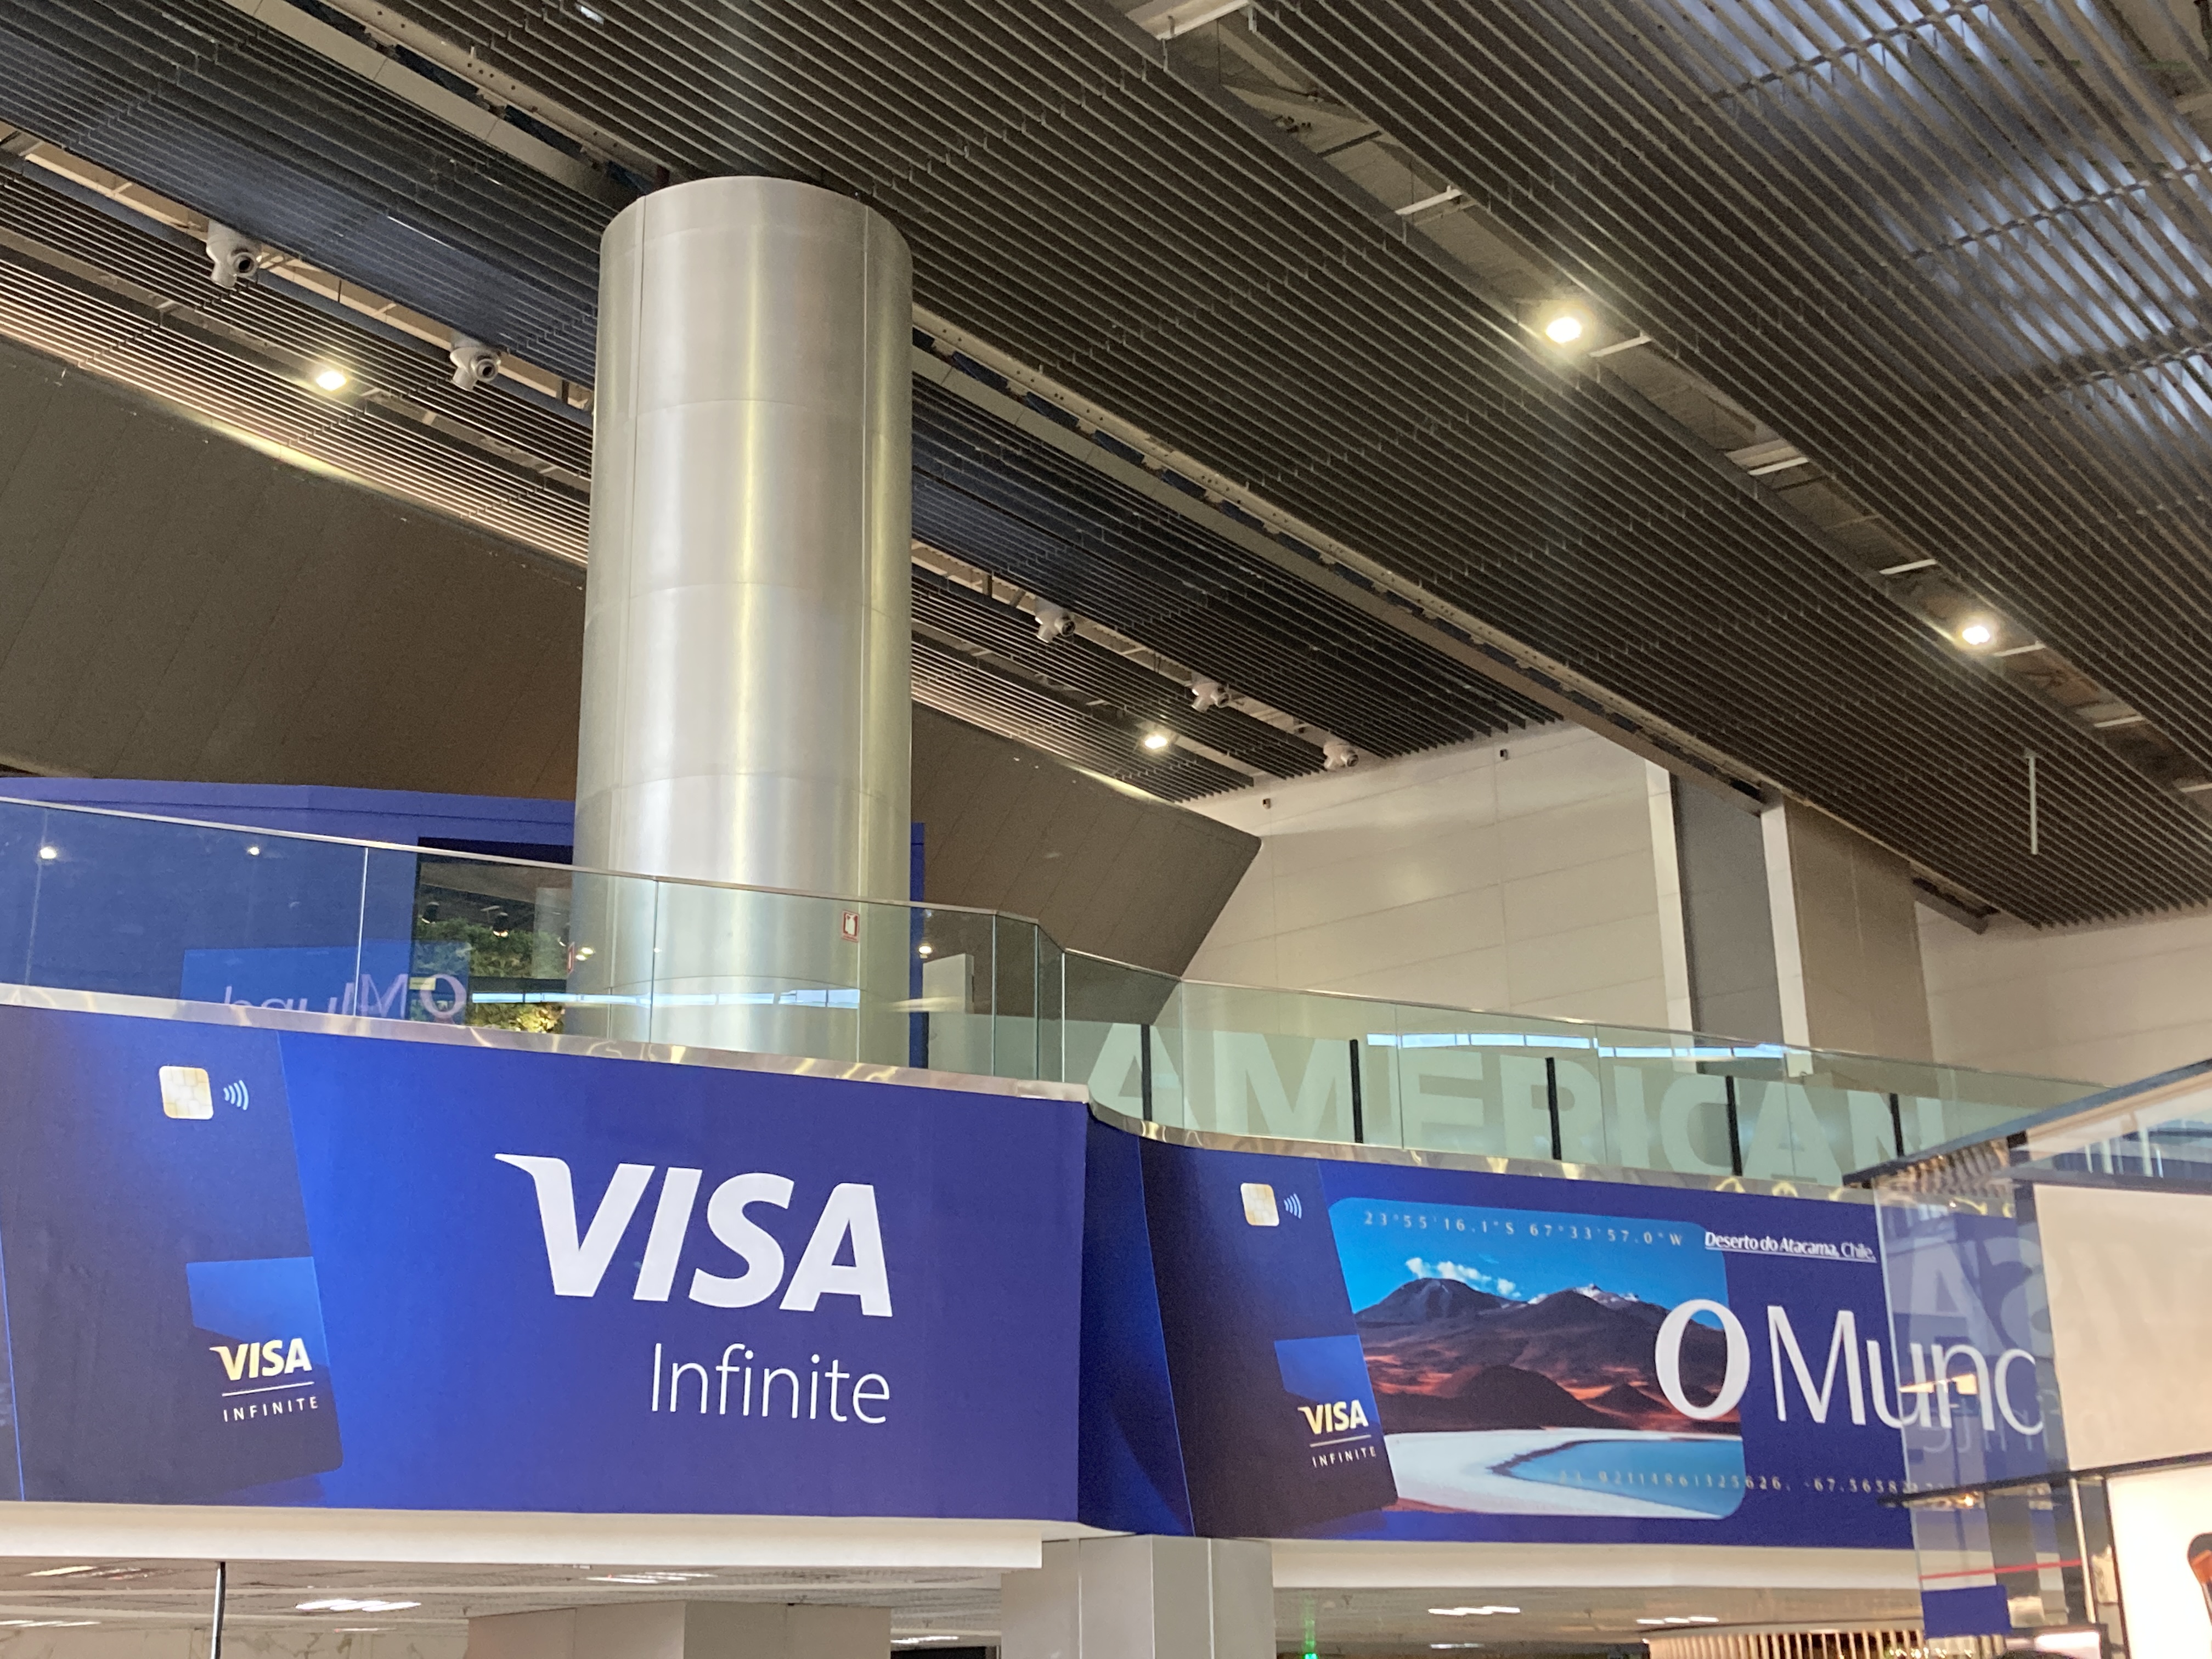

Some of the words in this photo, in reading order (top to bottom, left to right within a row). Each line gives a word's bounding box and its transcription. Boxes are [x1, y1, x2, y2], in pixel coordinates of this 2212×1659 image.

[1088, 1023, 1945, 1187] AMERICAN
[494, 1153, 893, 1317] VISA
[1705, 1231, 1758, 1250] Deserto
[1760, 1235, 1779, 1252] do
[1779, 1237, 1840, 1257] Atacama,
[209, 1338, 312, 1381] VISA
[1655, 1299, 1750, 1420] O
[651, 1343, 890, 1424] Infinite
[223, 1396, 319, 1422] INFINITE
[1297, 1400, 1369, 1434] VISA
[1312, 1446, 1377, 1469] INFINITE
